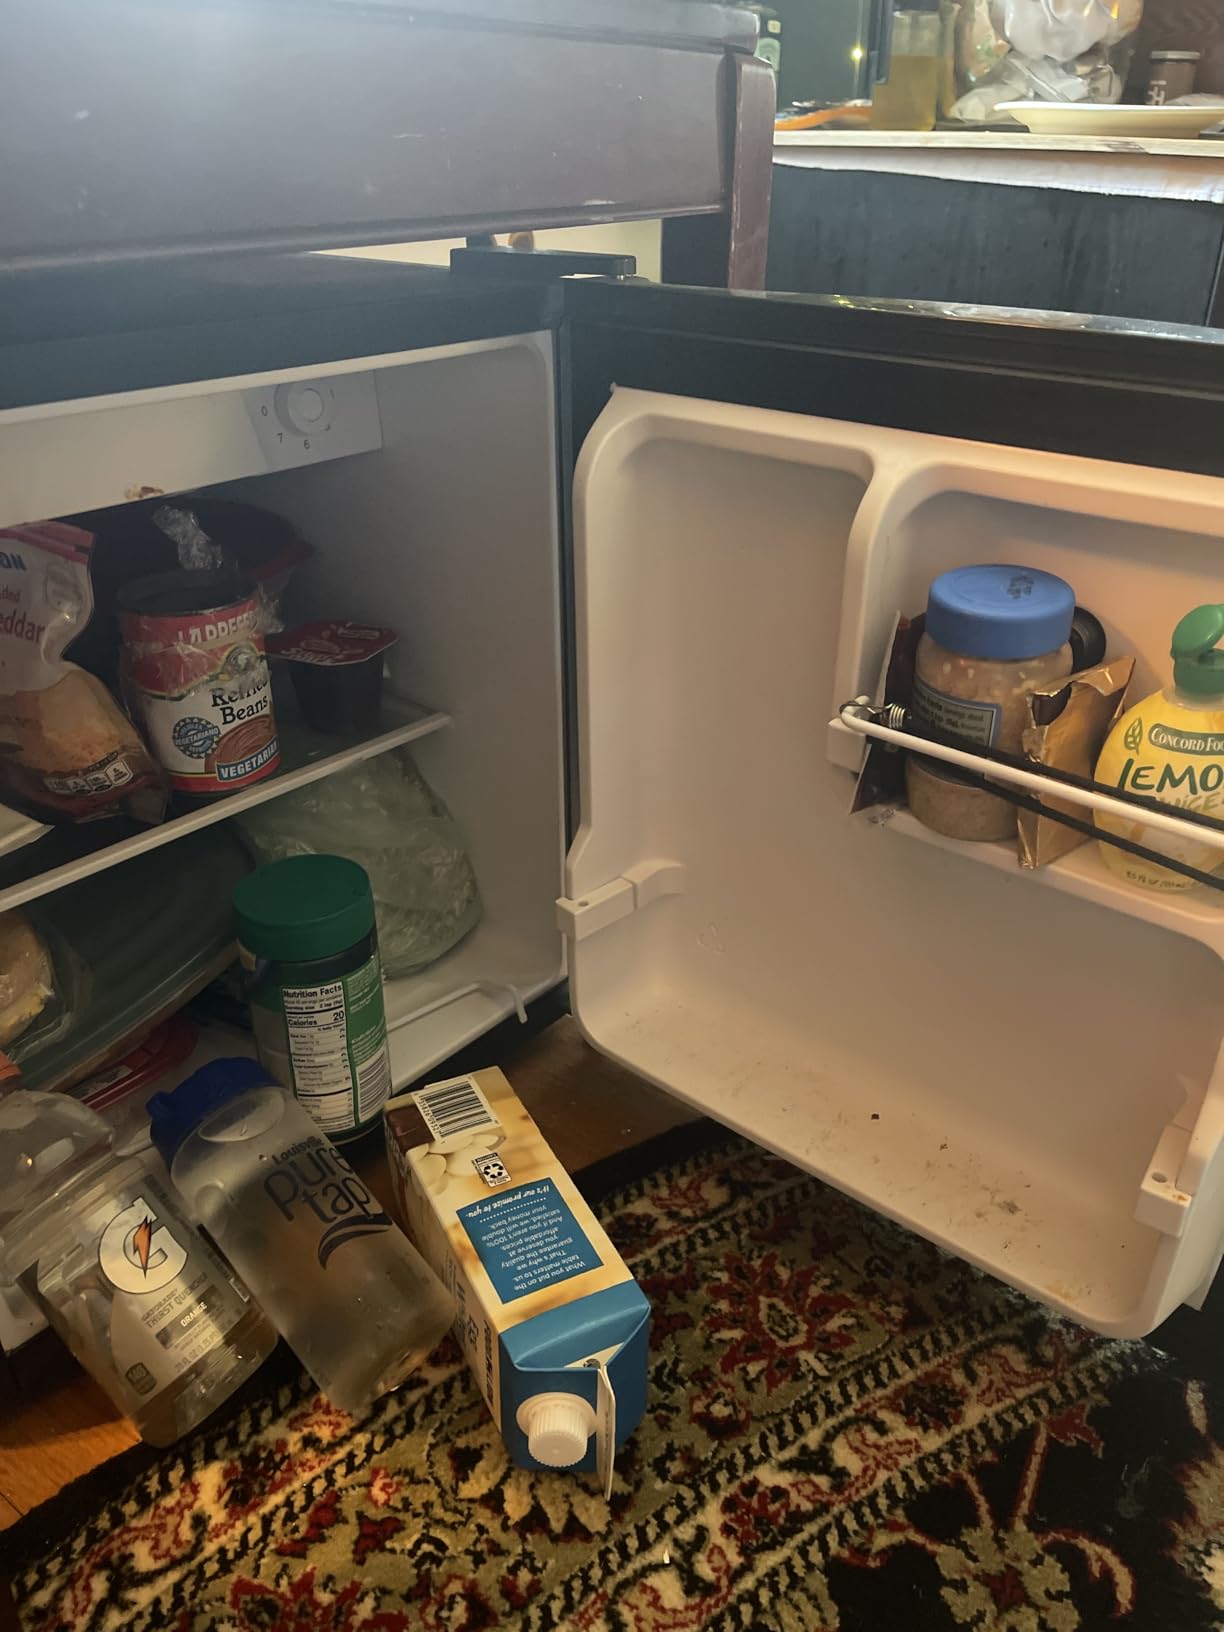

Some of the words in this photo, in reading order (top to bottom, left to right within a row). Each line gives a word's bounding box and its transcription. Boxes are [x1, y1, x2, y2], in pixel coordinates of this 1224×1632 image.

[276, 432, 283, 443] 7
[304, 439, 311, 450] 6
[220, 694, 269, 725] Beans
[1152, 727, 1204, 751] CONCORD
[283, 989, 318, 999] Nutrition
[320, 984, 342, 996] Facts
[288, 1018, 317, 1026] Calories
[333, 1012, 344, 1022] 20
[264, 1146, 351, 1221] pure
[536, 1185, 550, 1194] It's
[303, 1175, 370, 1222] tap
[491, 1192, 522, 1208] promise
[532, 1205, 546, 1213] your
[507, 1210, 530, 1222] money
[549, 1216, 563, 1225] And
[529, 1222, 541, 1230] you
[481, 1228, 505, 1241] double
[508, 1228, 528, 1239] aren't
[524, 1226, 559, 1242] affordable
[100, 1196, 189, 1294] G
[518, 1240, 544, 1253] deserve
[538, 1237, 573, 1254] guarantee
[500, 1255, 525, 1268] quality
[544, 1249, 566, 1261] That's
[561, 1254, 579, 1264] table
[528, 1257, 543, 1267] why
[534, 1261, 560, 1274] matters
[565, 1261, 585, 1272] What
[537, 1273, 550, 1282] put
[551, 1267, 564, 1276] you
[514, 1283, 526, 1291] the
[146, 1303, 174, 1329] THIRST
[180, 1302, 207, 1327] ORANGE
